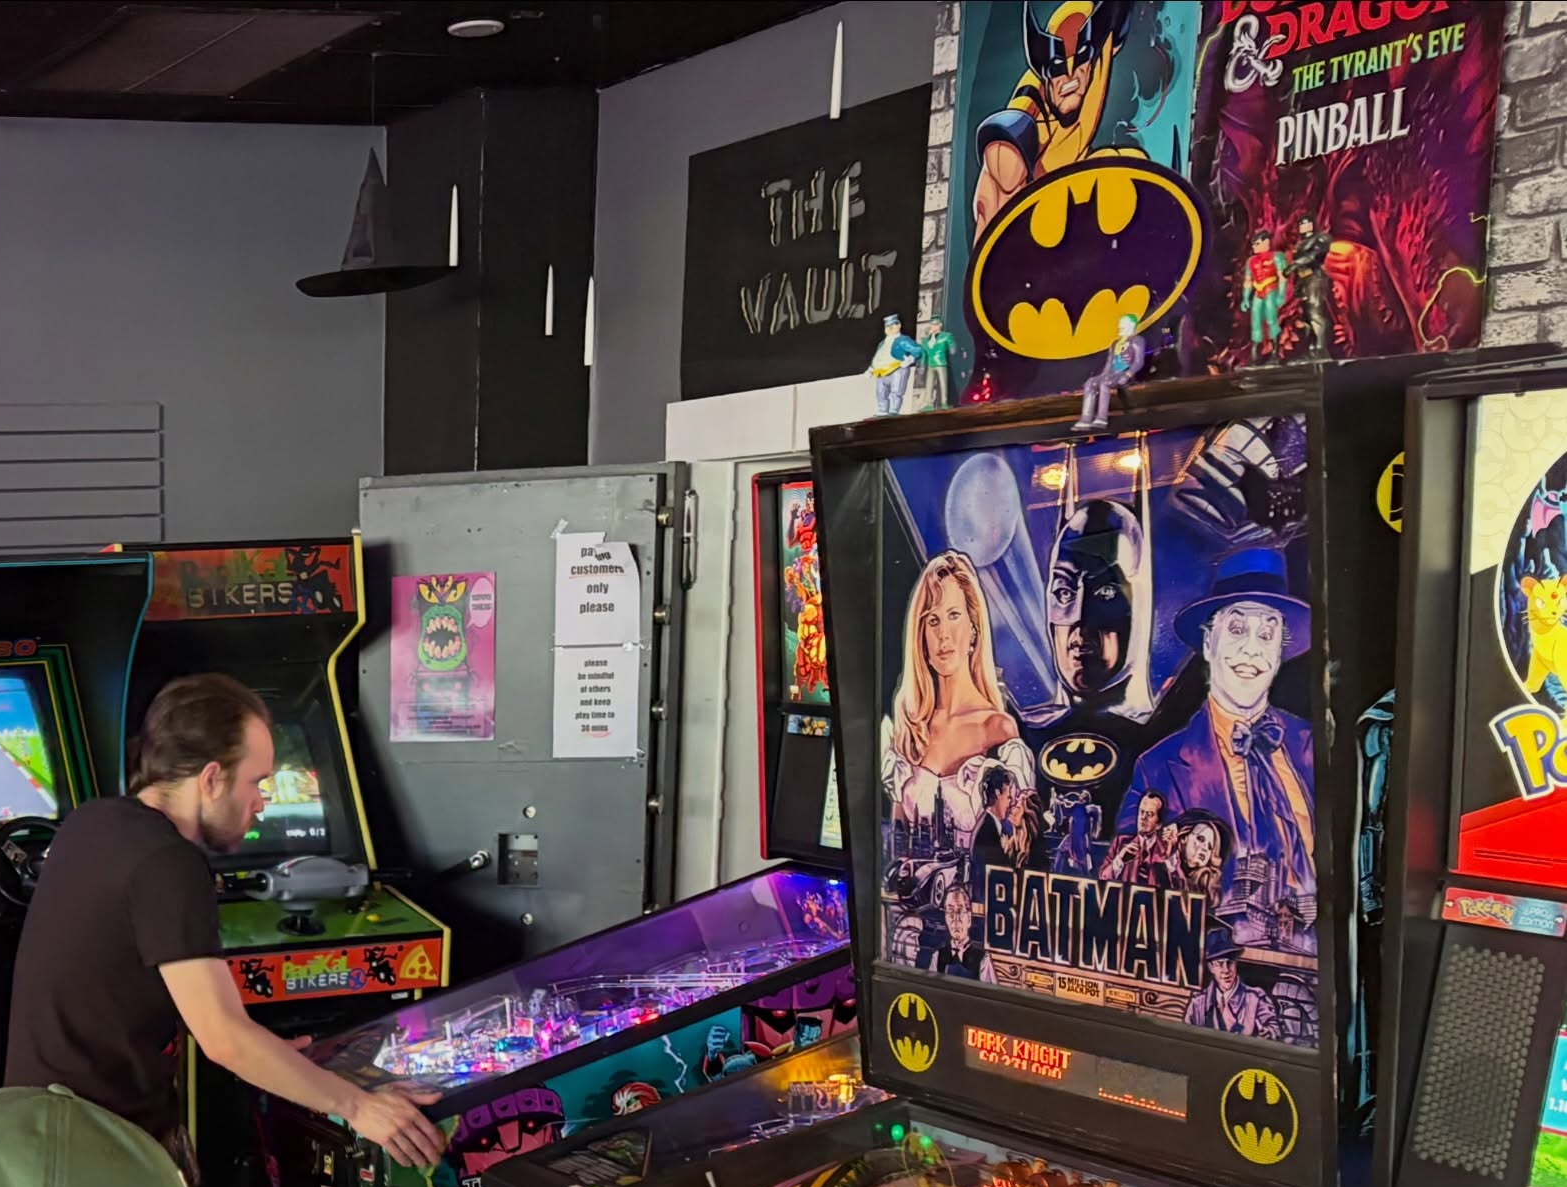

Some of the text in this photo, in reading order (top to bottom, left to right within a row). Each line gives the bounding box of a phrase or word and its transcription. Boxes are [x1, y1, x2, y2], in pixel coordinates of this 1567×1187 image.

[1292, 22, 1466, 95] THE TYRANT'S EYE
[1275, 87, 1410, 167] PINBALL
[761, 161, 866, 247] THE
[740, 250, 898, 335] VAULT
[188, 582, 295, 609] BIKERS
[586, 582, 609, 594] only
[579, 601, 615, 614] please
[984, 863, 1207, 992] BATMAN
[285, 972, 350, 991] BIKERS
[1058, 976, 1067, 990] 15
[1067, 976, 1099, 990] MILLION
[1067, 983, 1101, 998] JACKPOT
[967, 1027, 1072, 1070] DARK KNIGHT
